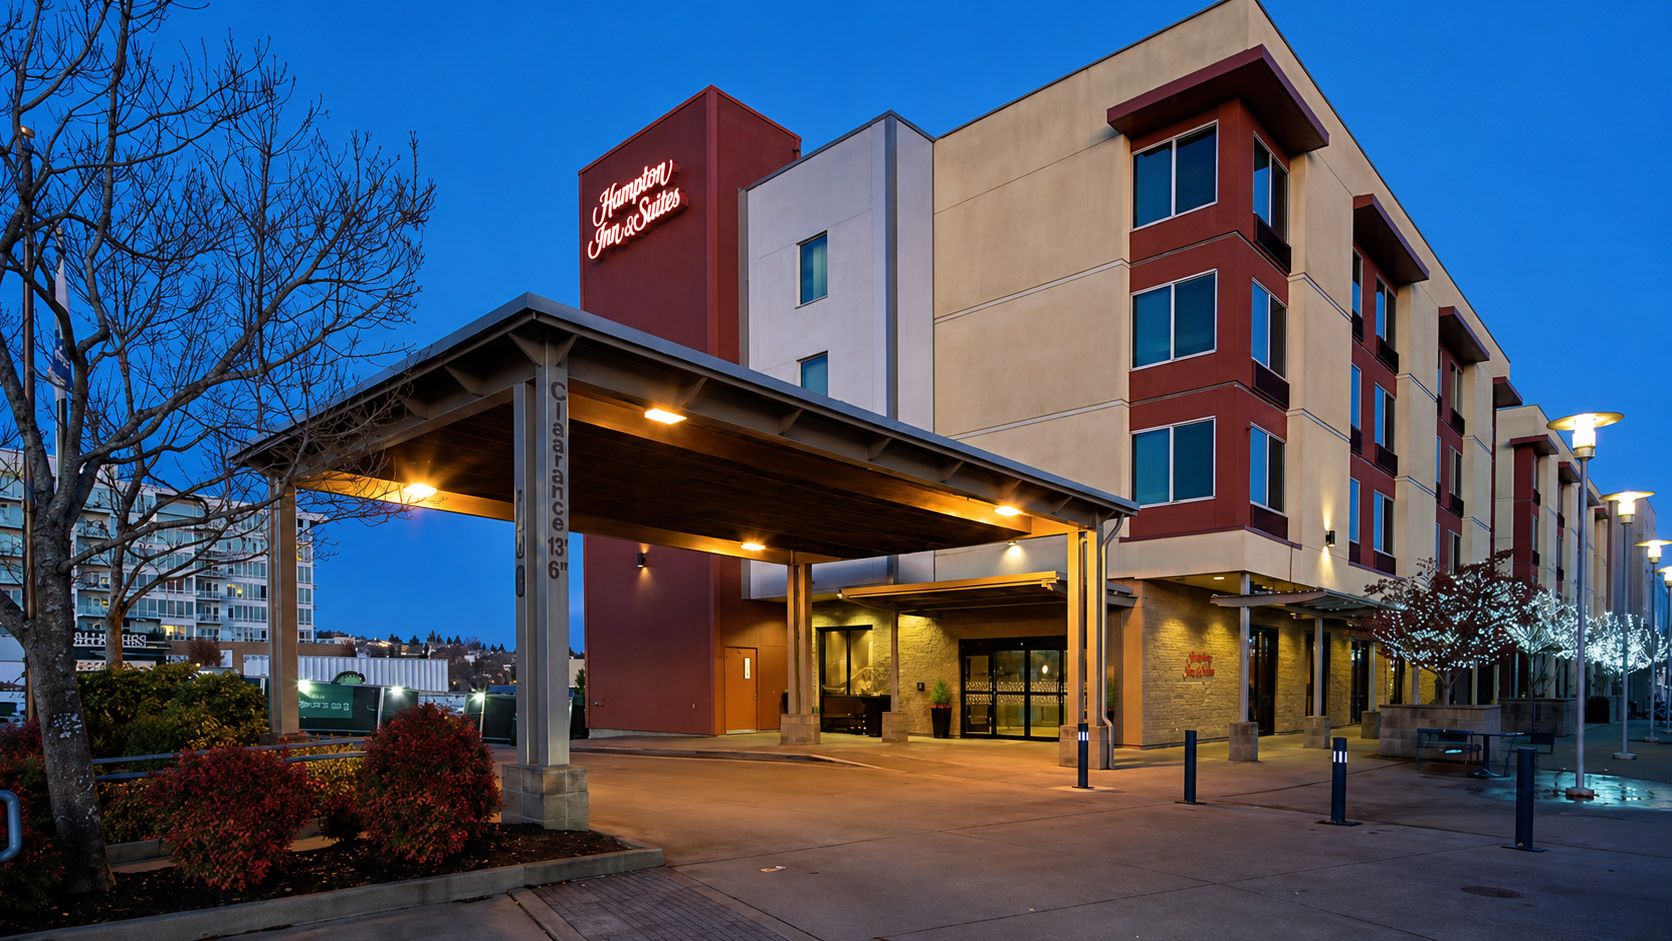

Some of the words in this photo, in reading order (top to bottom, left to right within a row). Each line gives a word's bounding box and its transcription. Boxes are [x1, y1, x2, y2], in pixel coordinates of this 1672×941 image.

[587, 222, 625, 260] Inn
[624, 215, 636, 237] &
[633, 187, 681, 232] Suites
[592, 159, 673, 227] Hampton
